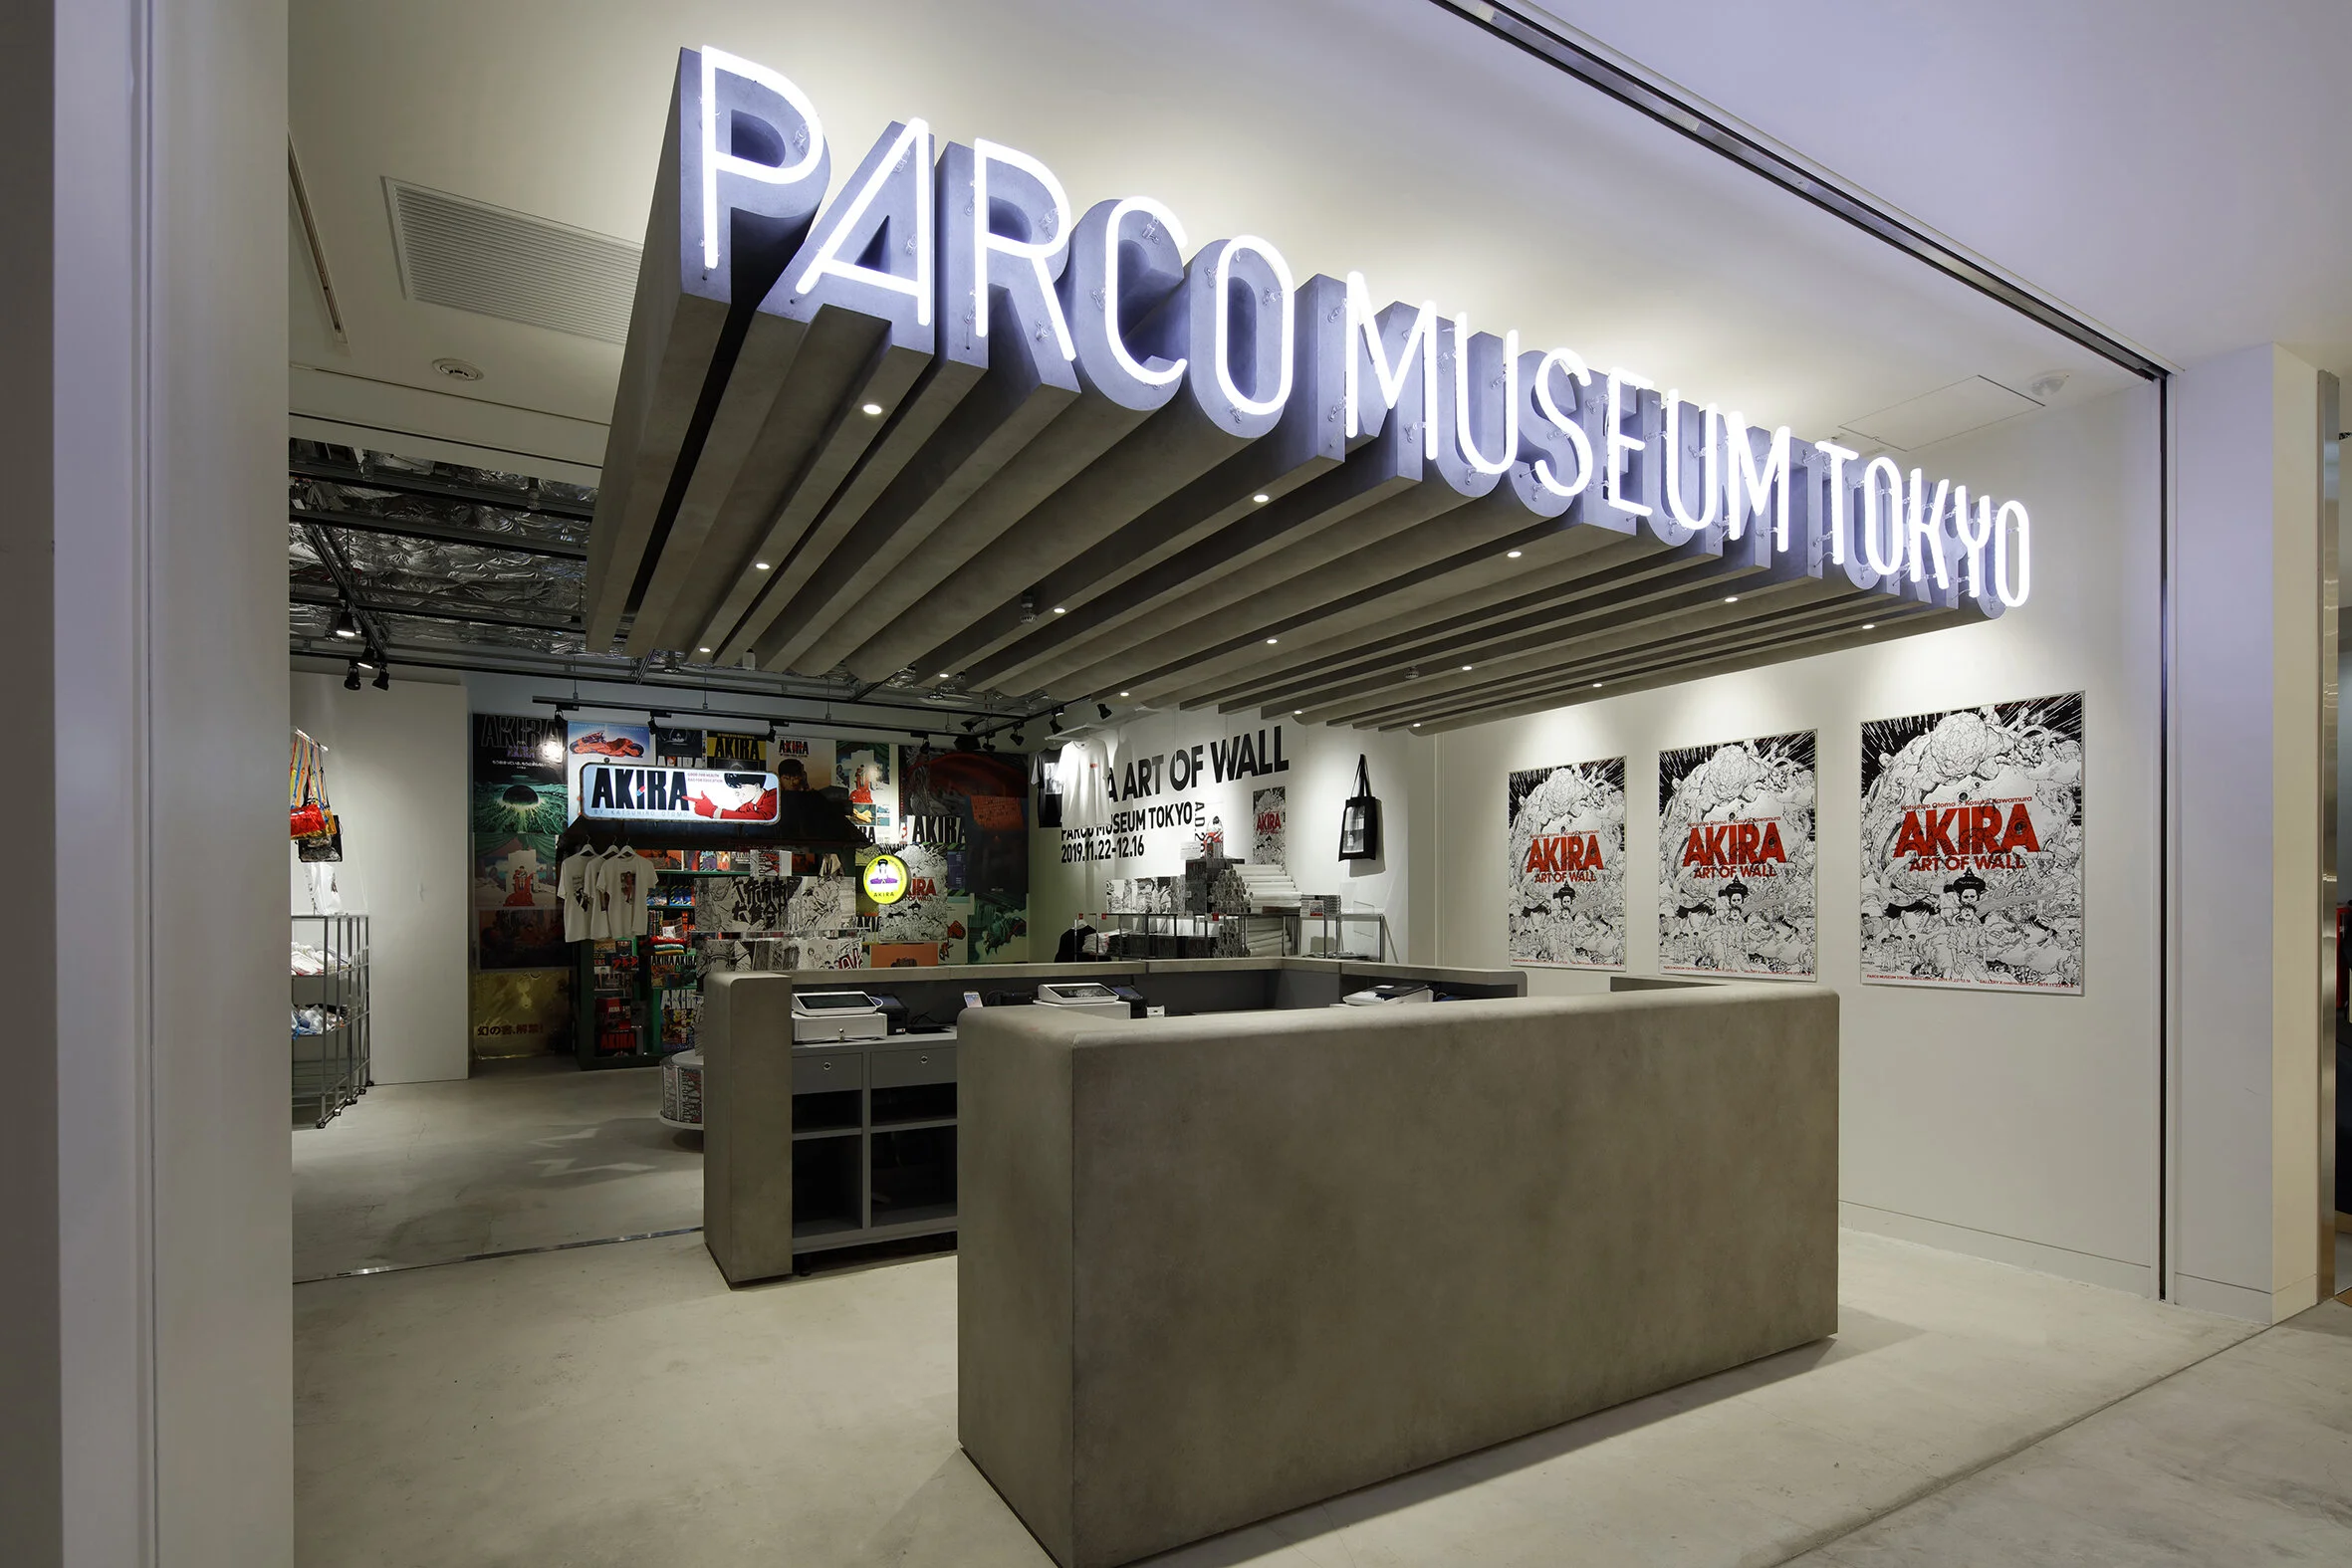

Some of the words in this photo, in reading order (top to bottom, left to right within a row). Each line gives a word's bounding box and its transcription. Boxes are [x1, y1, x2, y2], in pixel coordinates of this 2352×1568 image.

[687, 45, 1294, 426] PARCO
[1320, 271, 1790, 560] MUSEUM
[1807, 440, 2029, 611] TOKYO
[714, 737, 760, 761] AKIRA
[779, 740, 809, 756] AKIRA
[1122, 755, 1164, 801] ART
[1169, 745, 1204, 791] OF
[1210, 726, 1289, 784] WALL
[590, 767, 690, 810] AKIRA
[1148, 801, 1192, 829] TOKYO
[1256, 812, 1282, 831] AKIRA
[1682, 822, 1787, 867] AKIRA
[1893, 803, 2041, 858] AKIRA
[1061, 835, 1145, 863] 2019.11.22-12.16
[1526, 834, 1604, 873] AKIRA
[1909, 857, 1943, 871] ART
[1946, 856, 1970, 870] OF
[1974, 854, 2027, 870] WALL
[1534, 873, 1552, 883] ART
[1553, 872, 1567, 883] OF
[1568, 871, 1597, 883] WALL
[1694, 866, 1717, 879] ART
[1718, 866, 1737, 878] OF
[1739, 864, 1777, 878] WALL
[651, 956, 675, 966] AKIRA
